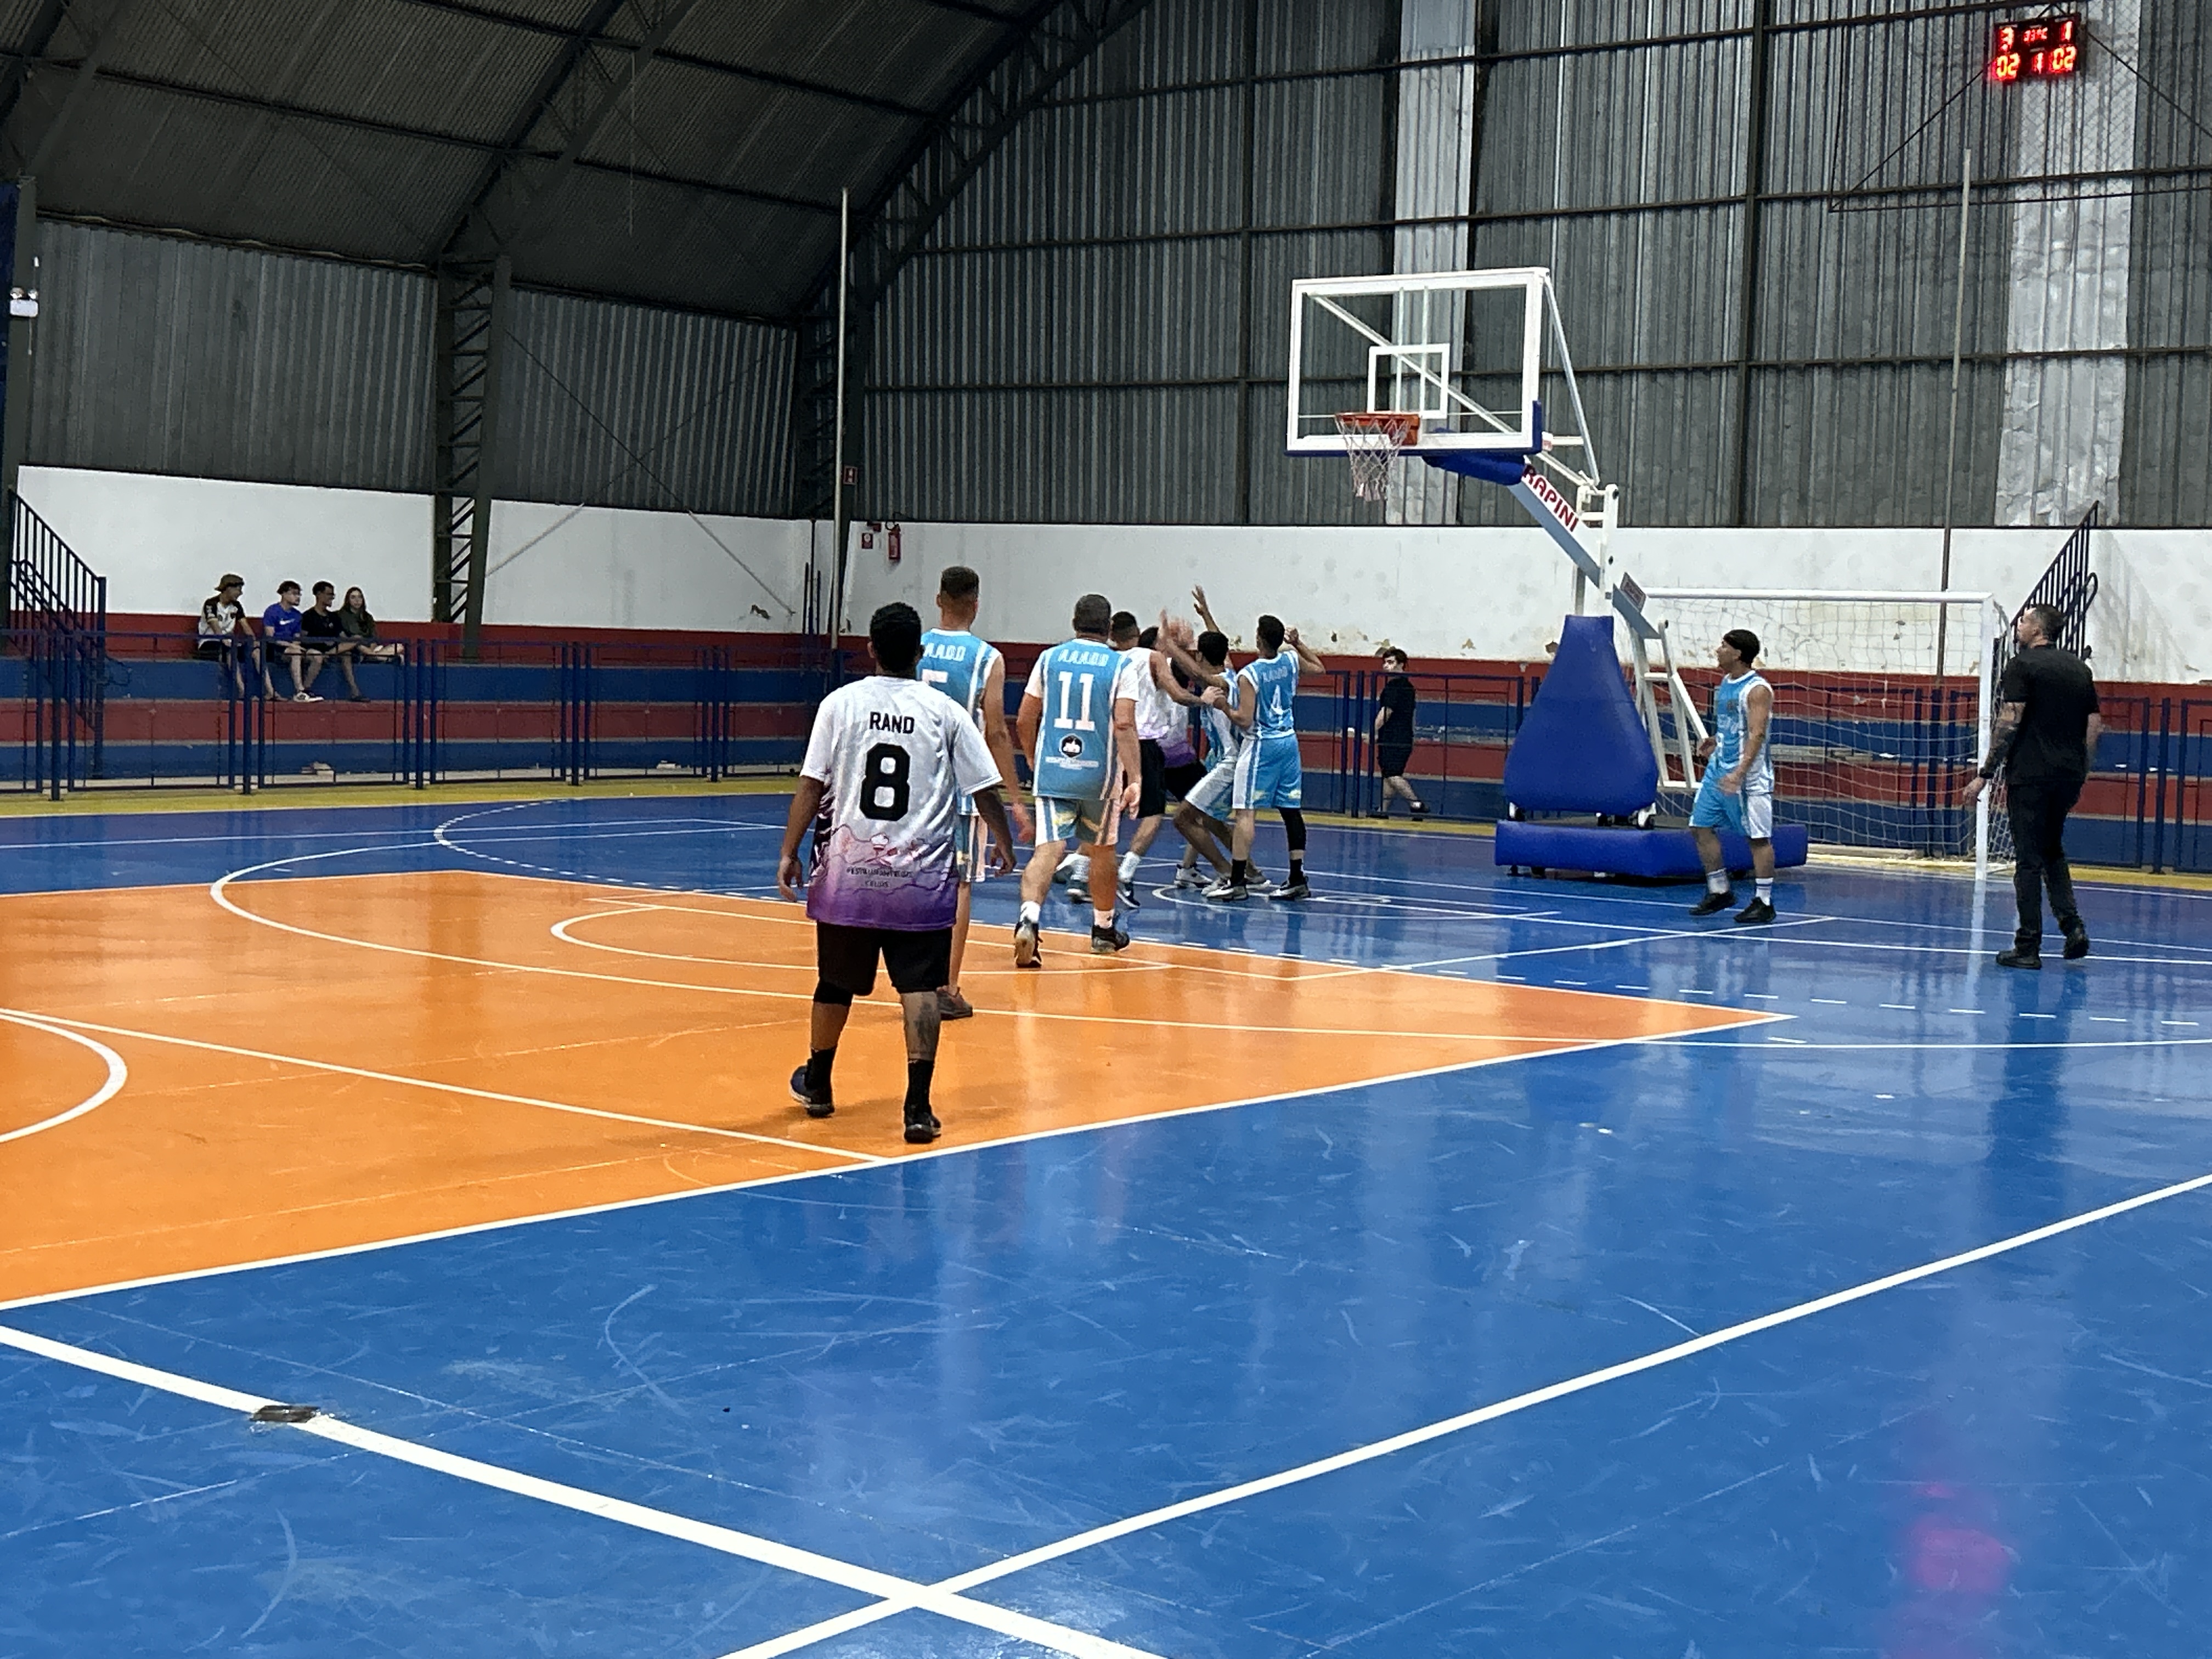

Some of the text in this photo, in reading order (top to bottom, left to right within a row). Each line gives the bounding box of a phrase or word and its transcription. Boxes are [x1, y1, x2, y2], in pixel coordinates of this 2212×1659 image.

[1996, 53, 2021, 78] 02
[2052, 46, 2077, 70] 02
[1522, 464, 1579, 532] RAPINI
[1054, 671, 1096, 731] 11
[869, 712, 915, 734] RAND
[859, 743, 911, 822] 8
